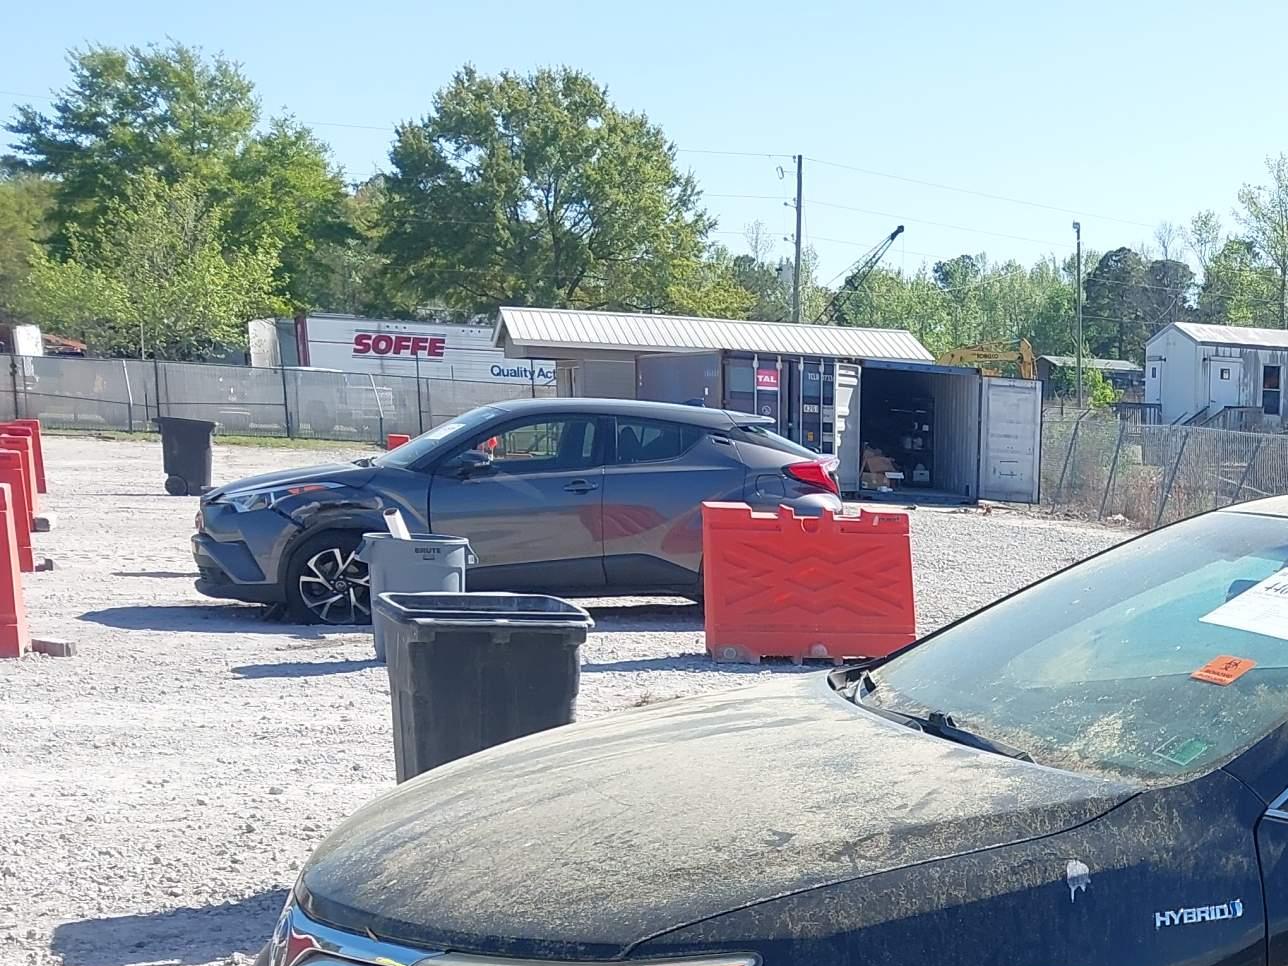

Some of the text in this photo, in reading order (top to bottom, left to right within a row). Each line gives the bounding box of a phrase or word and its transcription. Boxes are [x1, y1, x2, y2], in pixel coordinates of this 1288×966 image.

[353, 334, 446, 357] SOFFE
[490, 364, 536, 380] Quality
[757, 375, 777, 383] TAL
[1155, 904, 1229, 927] HYBRID
